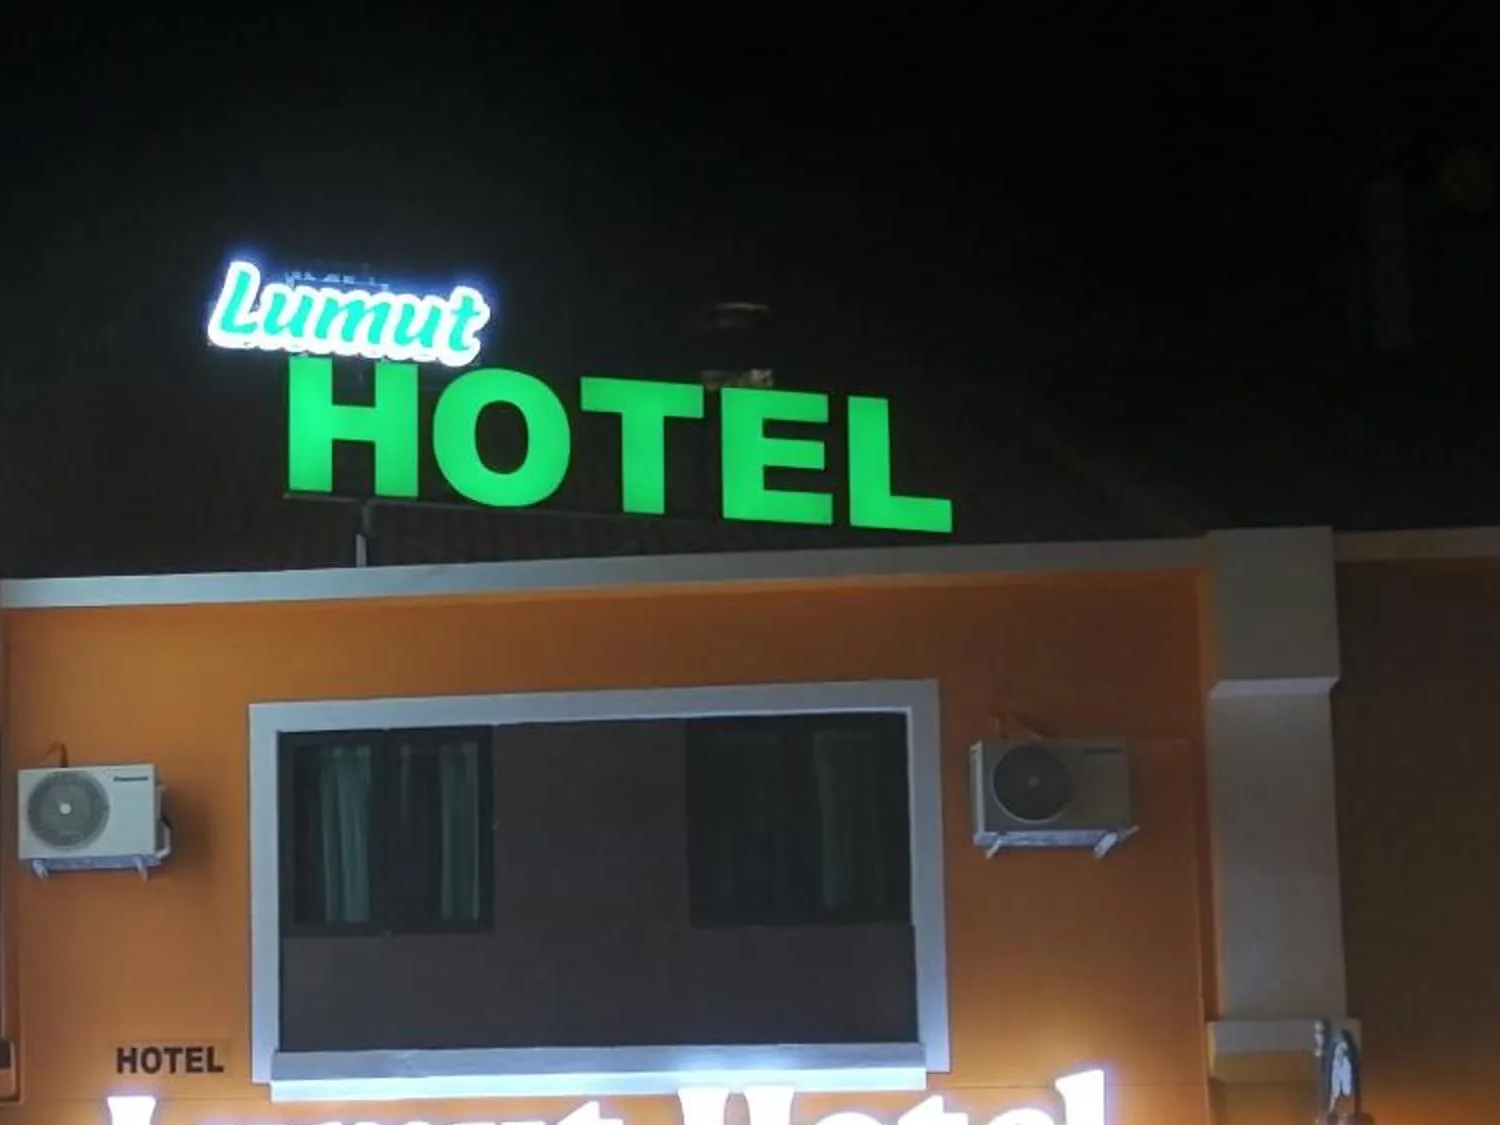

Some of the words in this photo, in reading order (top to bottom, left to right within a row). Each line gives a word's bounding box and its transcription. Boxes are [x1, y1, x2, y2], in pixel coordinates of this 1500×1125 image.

[209, 263, 489, 364] Lumut
[288, 356, 953, 533] HOTEL
[116, 1047, 224, 1073] HOTEL
